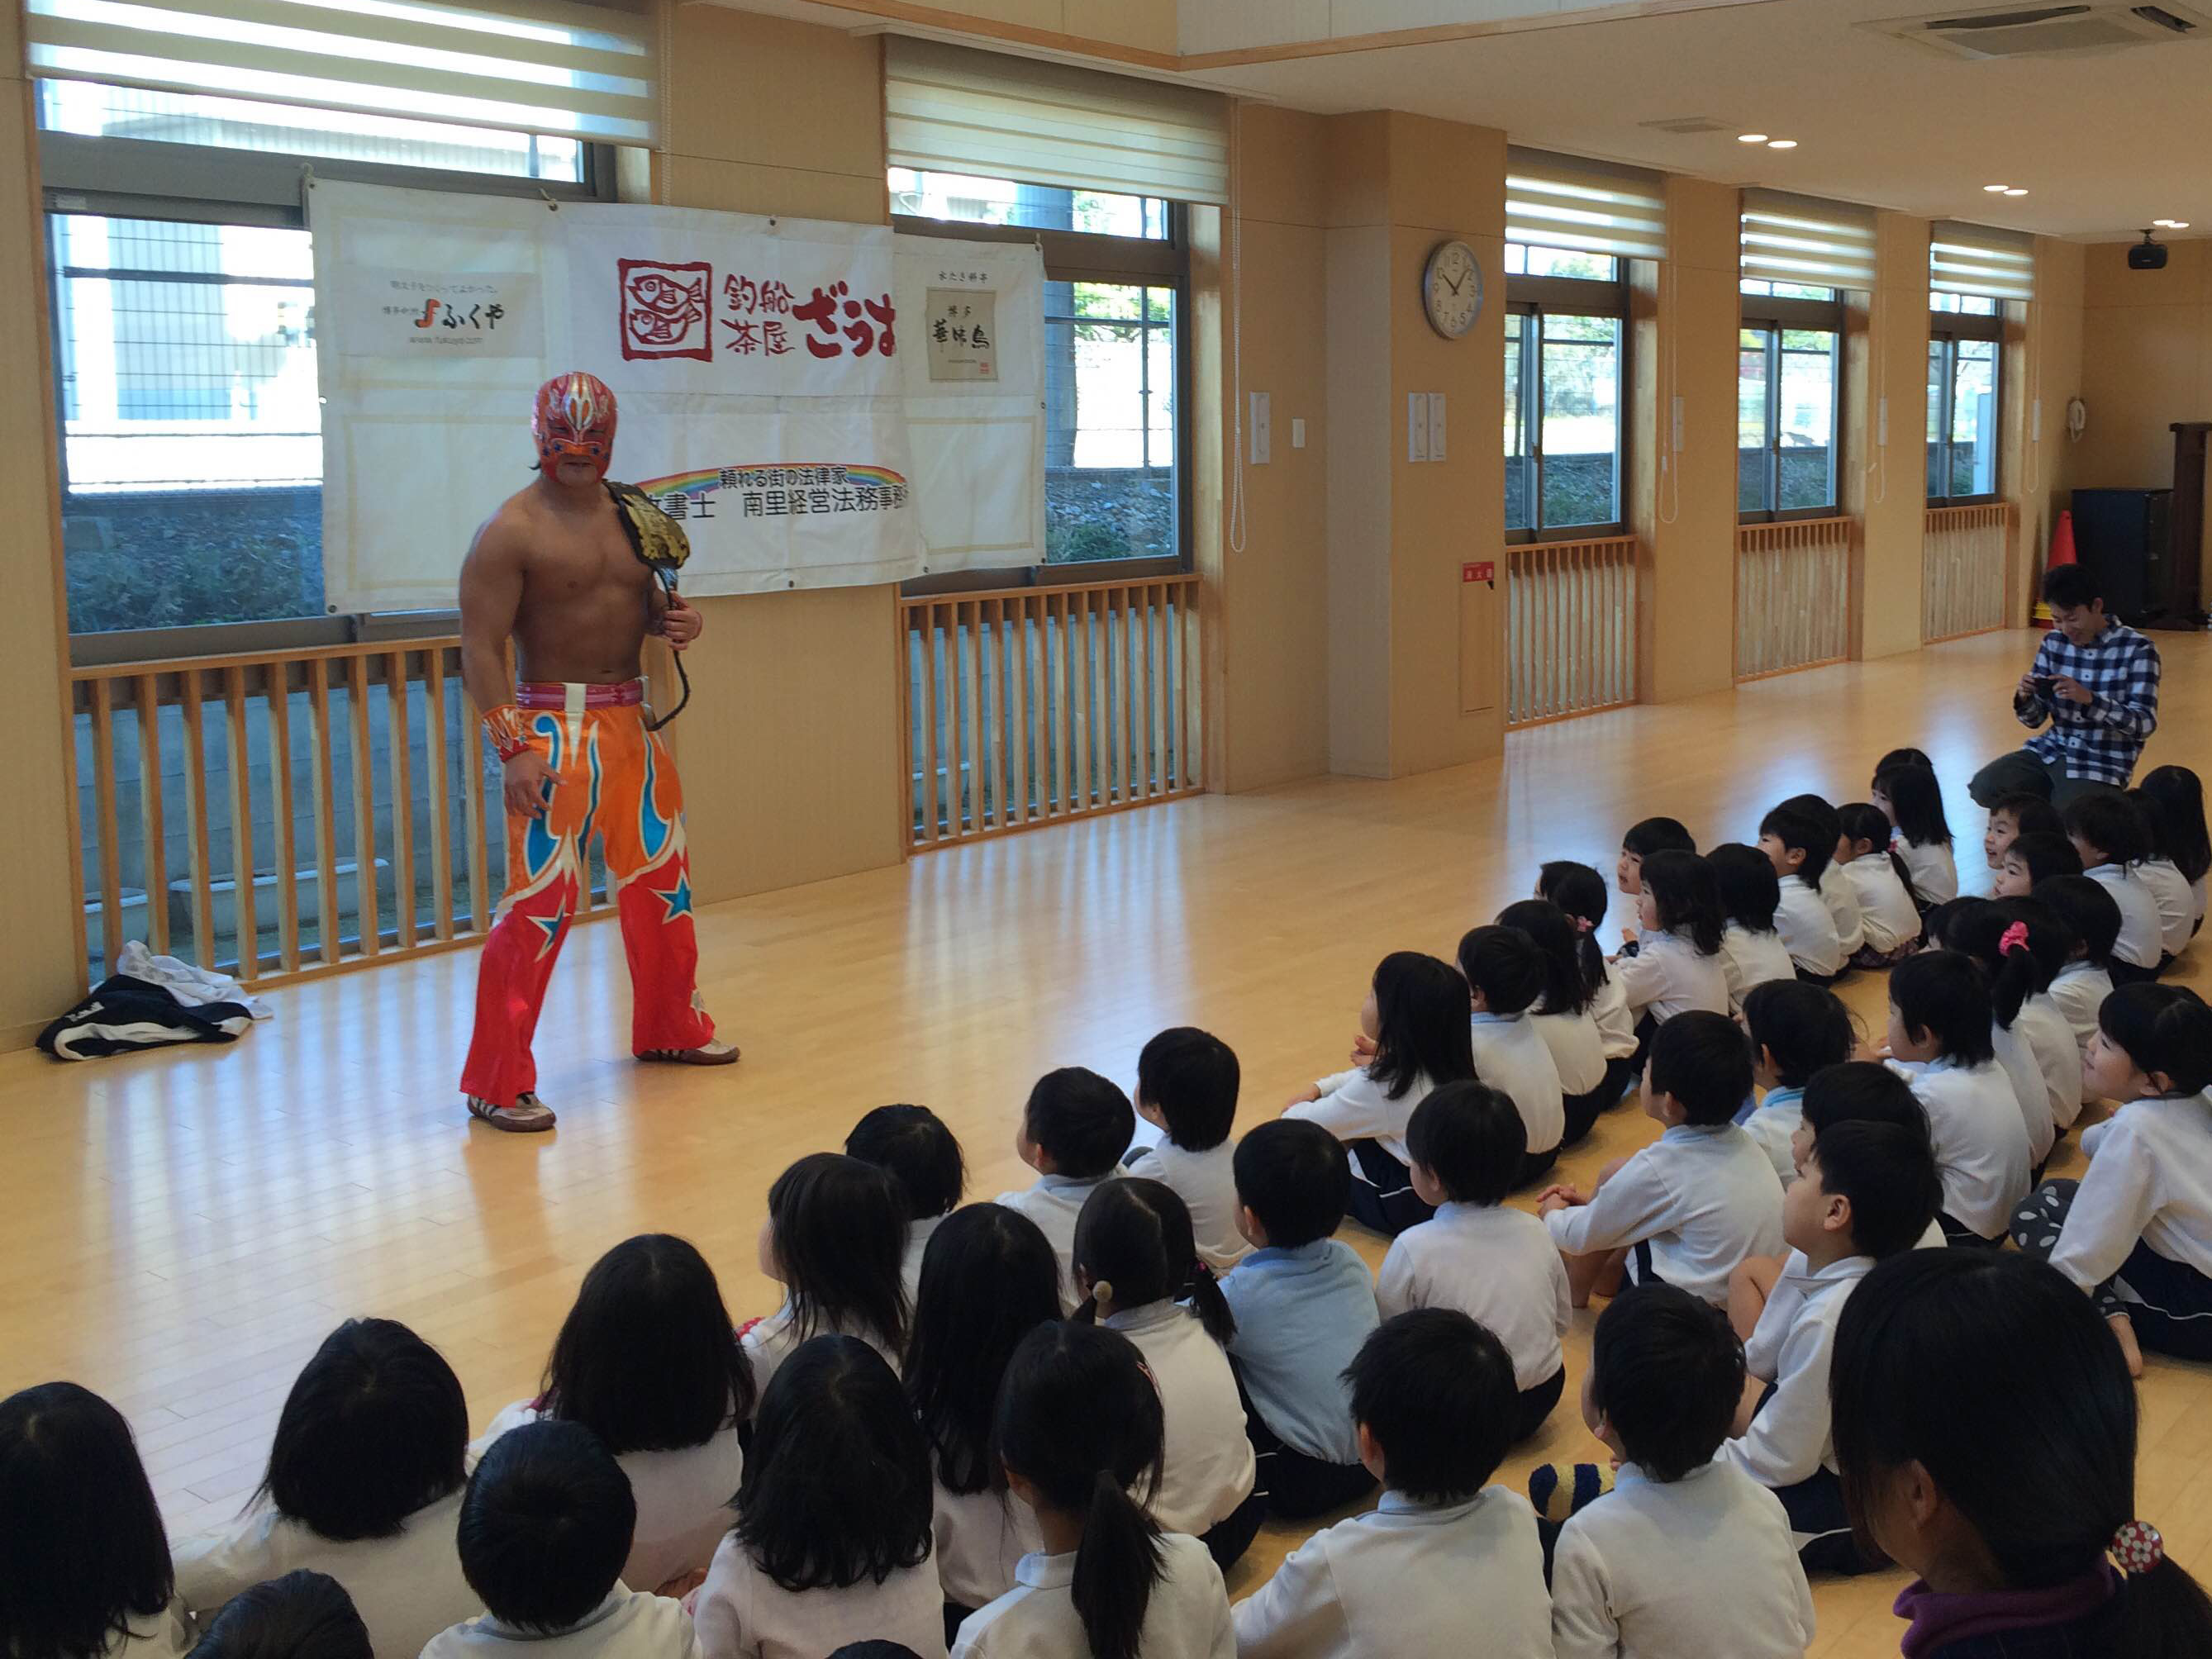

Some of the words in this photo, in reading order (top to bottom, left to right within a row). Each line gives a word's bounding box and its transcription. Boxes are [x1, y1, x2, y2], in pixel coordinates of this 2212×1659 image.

[724, 273, 795, 314] 釣船
[442, 303, 505, 330] ふくや
[721, 319, 795, 356] 茶屋
[719, 466, 848, 489] 頼れる街の法律家
